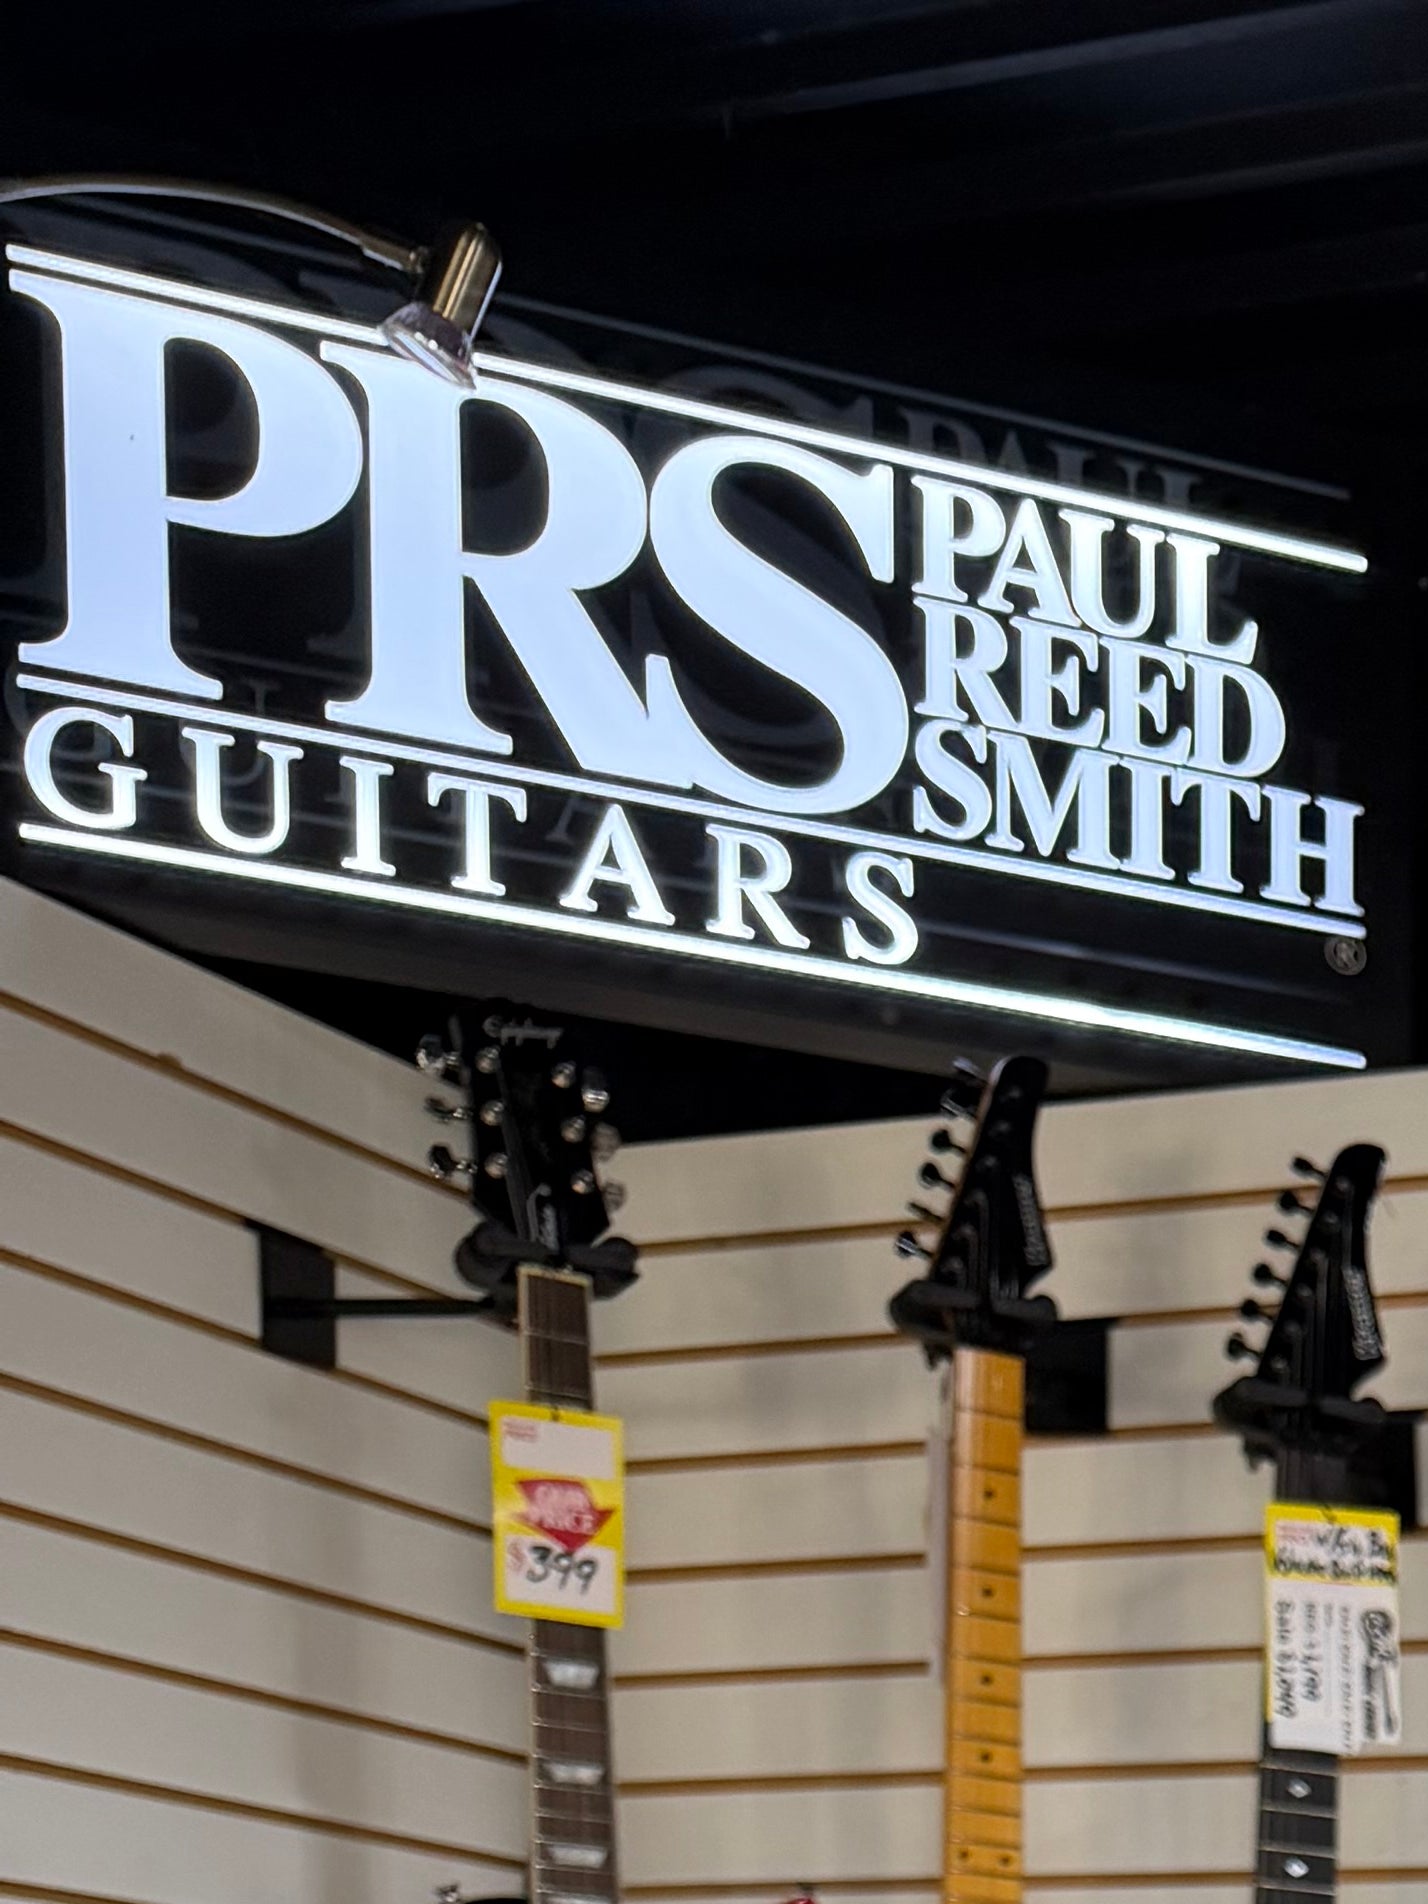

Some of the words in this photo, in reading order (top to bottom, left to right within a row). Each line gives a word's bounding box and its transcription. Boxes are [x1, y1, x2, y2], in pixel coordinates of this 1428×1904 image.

[9, 267, 910, 816] PRS
[910, 475, 1259, 663] PAUL
[912, 598, 1287, 779] REED
[22, 706, 919, 968] GUITARS
[912, 722, 1365, 918] SMITH
